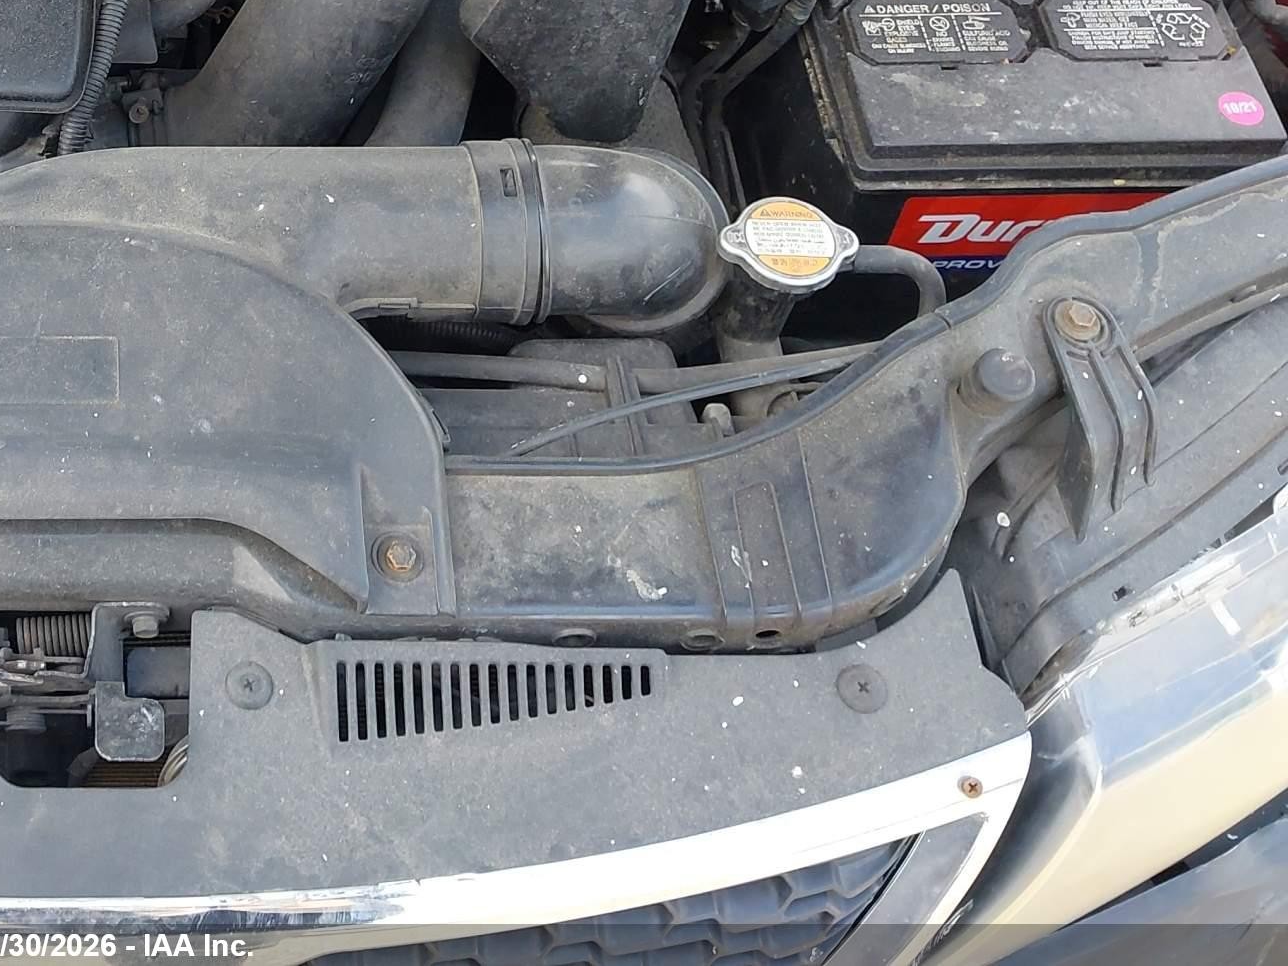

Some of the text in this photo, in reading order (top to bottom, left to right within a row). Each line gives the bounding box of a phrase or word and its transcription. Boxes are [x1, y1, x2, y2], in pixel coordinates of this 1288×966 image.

[876, 3, 991, 14] DANGER / POISON
[918, 214, 1048, 244] Dur
